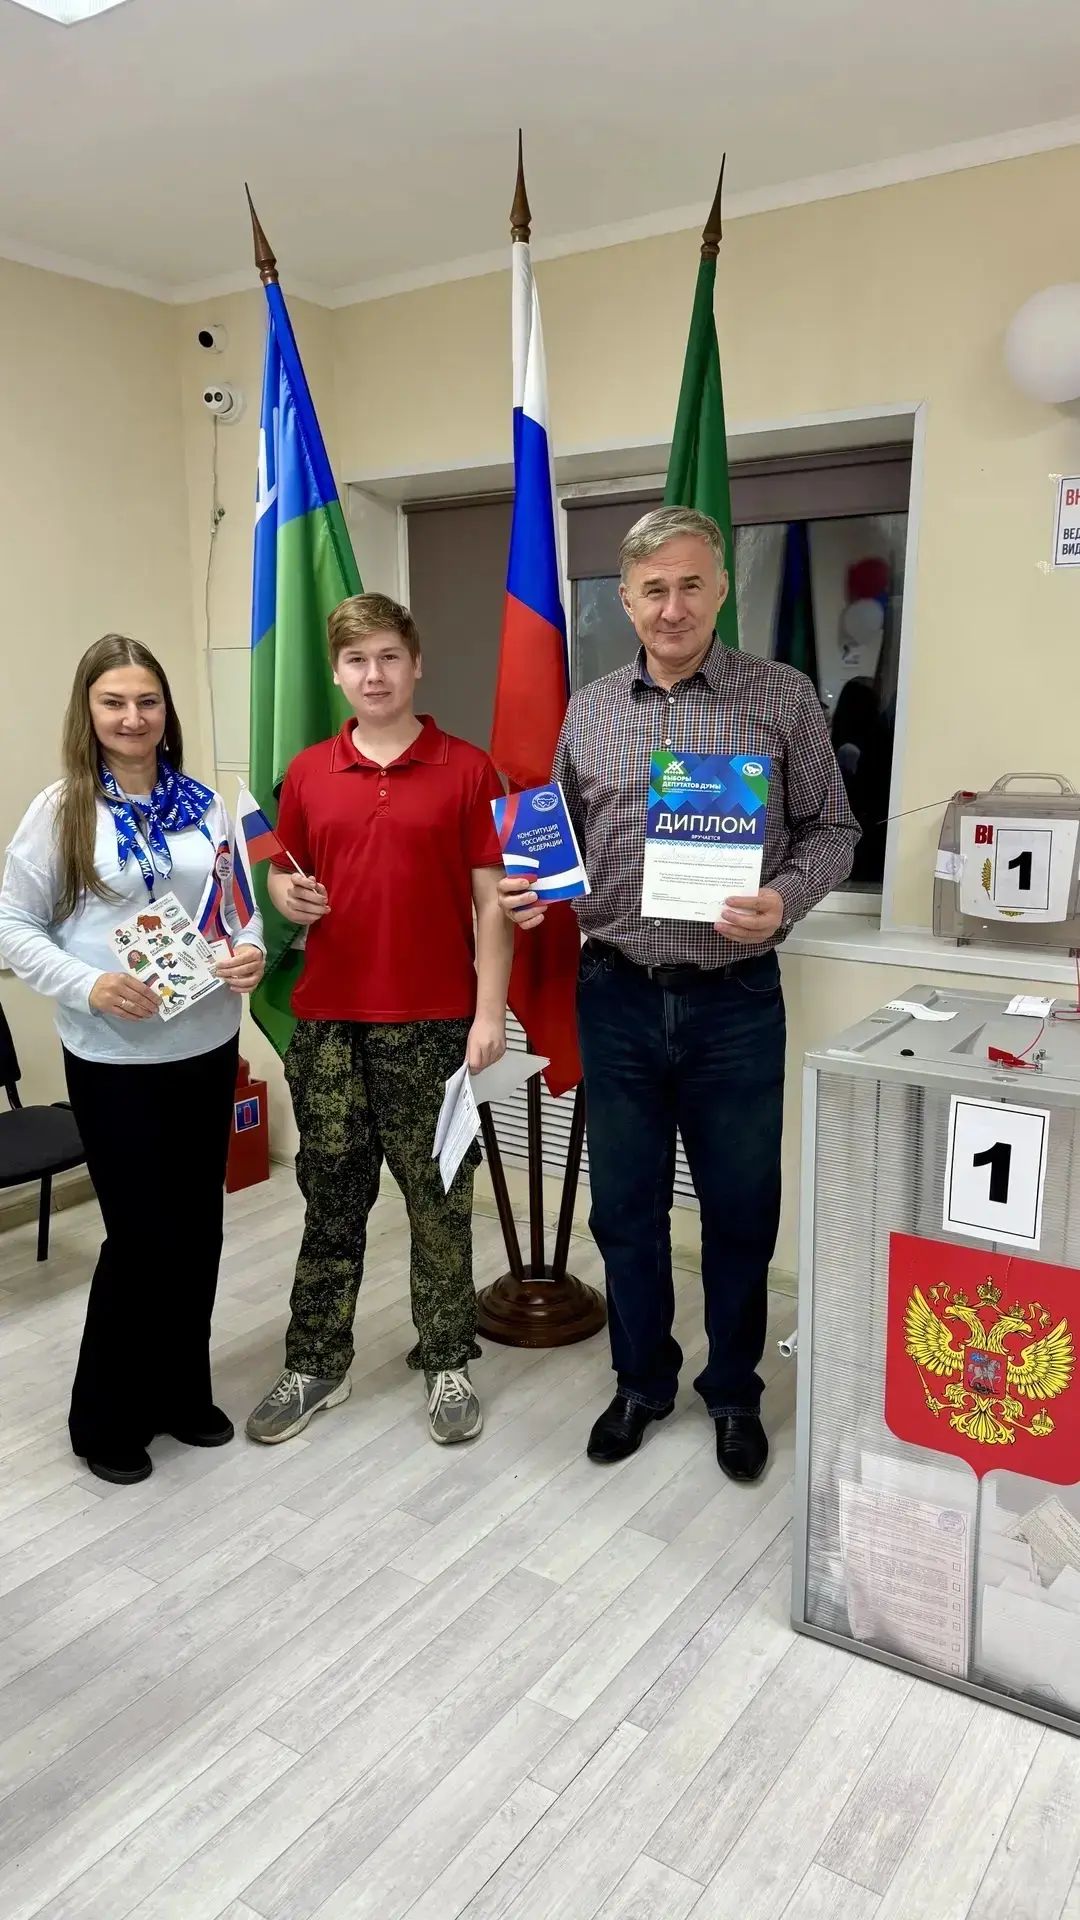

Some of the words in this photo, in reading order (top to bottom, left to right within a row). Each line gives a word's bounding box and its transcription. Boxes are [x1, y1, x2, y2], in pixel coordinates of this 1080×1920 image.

[662, 781, 700, 790] ДЕПУТАТОВ
[663, 775, 692, 783] ВЫБОРЫ
[188, 783, 208, 799] УИК
[182, 800, 199, 820] УИК
[517, 823, 559, 839] КОНСТИТУЦИЯ
[655, 813, 756, 834] ДИПЛОМ
[521, 831, 561, 846] РОССИЙСКОЙ
[528, 839, 563, 853] ФЕДЕРАЦИИ
[138, 858, 153, 879] УИК
[1008, 851, 1032, 890] 1
[973, 1141, 1012, 1204] 1
